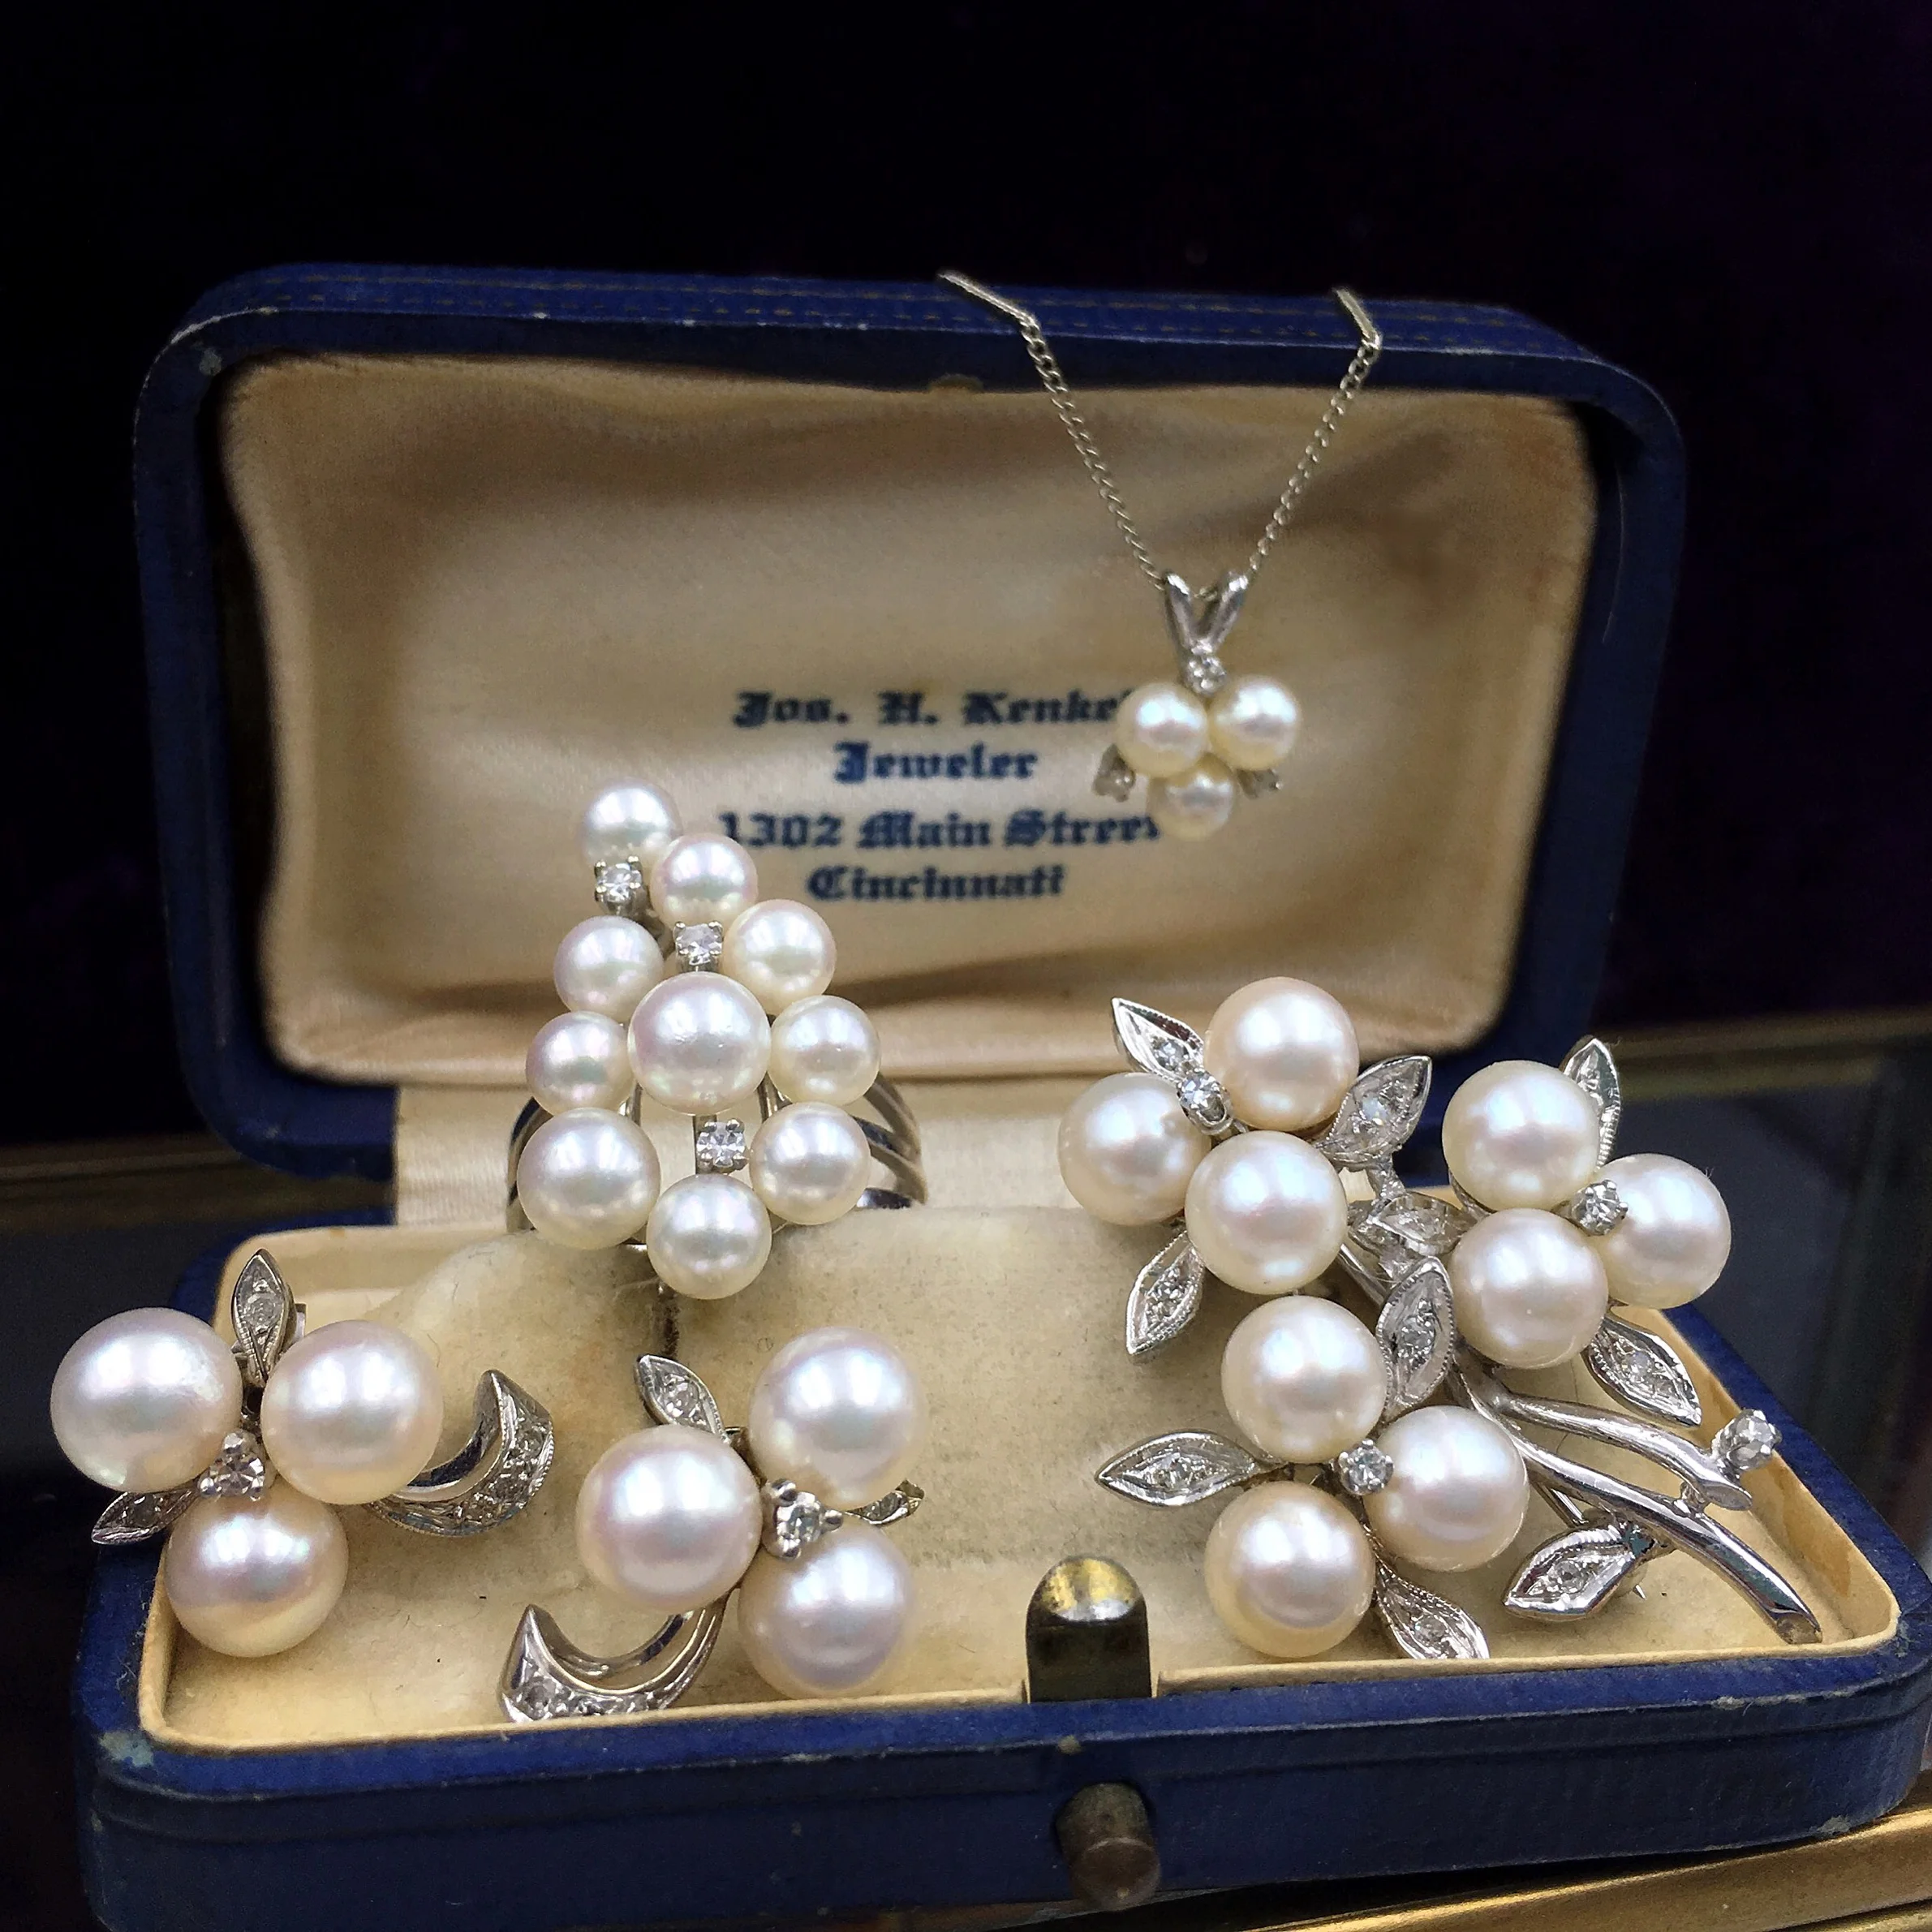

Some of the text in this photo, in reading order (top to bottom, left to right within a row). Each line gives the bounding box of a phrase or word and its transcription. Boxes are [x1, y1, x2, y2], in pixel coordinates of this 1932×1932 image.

[734, 689, 1134, 728] Jos. H. Kenke
[834, 741, 1037, 784] Jeweler
[719, 811, 844, 847] 1302
[856, 810, 991, 848] Main
[807, 863, 1065, 901] Cincinnati
